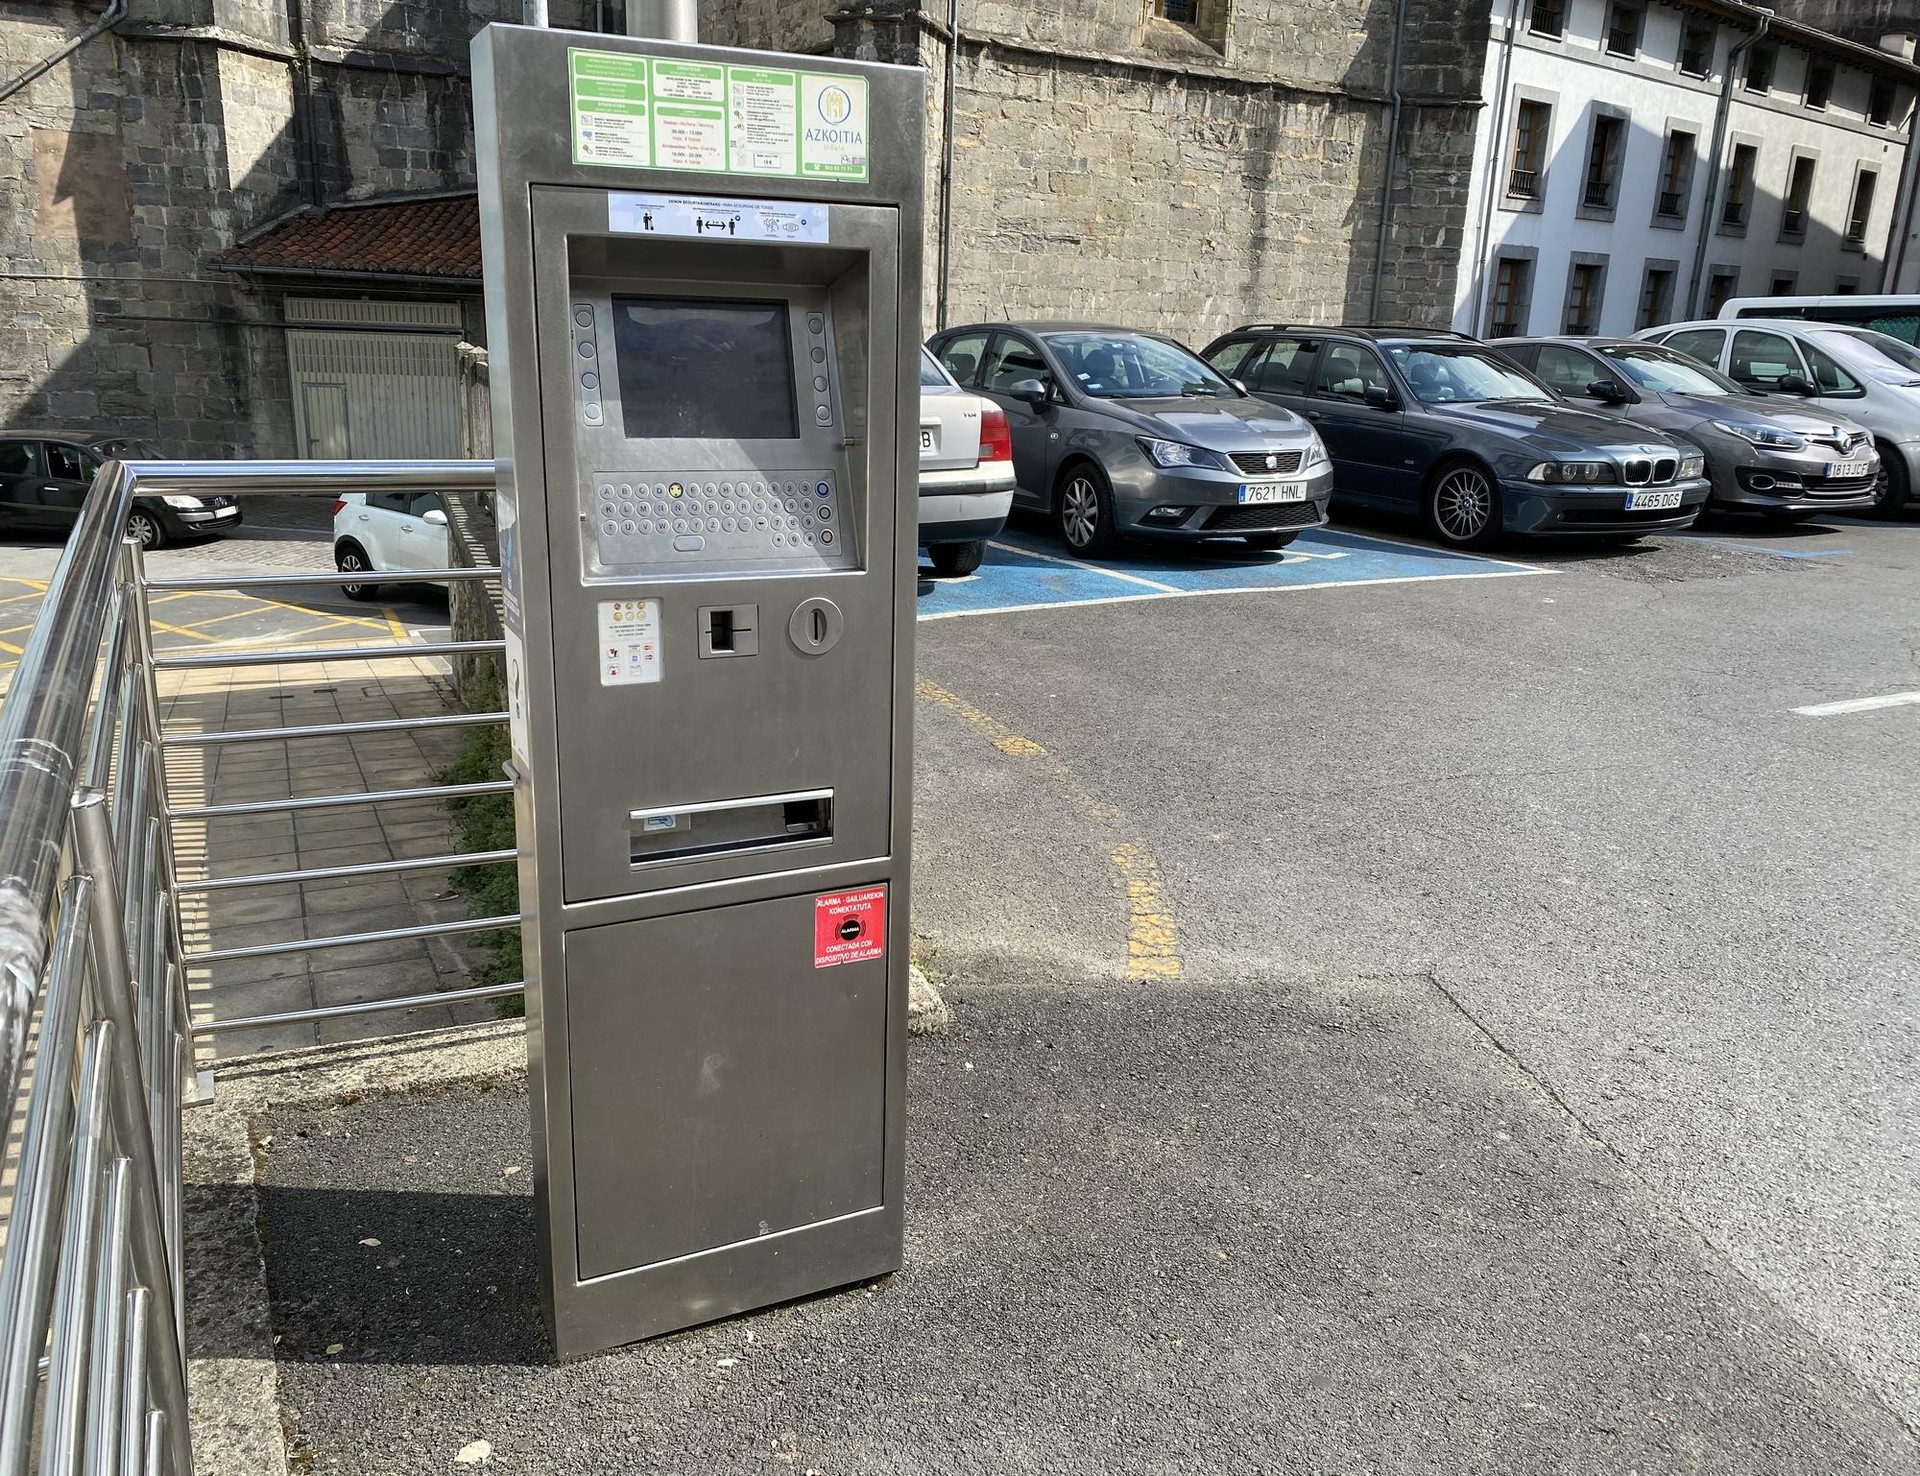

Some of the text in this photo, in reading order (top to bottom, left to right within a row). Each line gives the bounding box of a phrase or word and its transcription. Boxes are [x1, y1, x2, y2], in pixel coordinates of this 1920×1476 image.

[805, 128, 862, 144] AZKOITIA
[1833, 464, 1851, 475] 1813
[1248, 484, 1302, 501] 7621 HNL
[1635, 494, 1661, 507] 4465
[816, 898, 841, 907] ALARMA
[845, 891, 884, 903] GAILUAREKIN
[829, 903, 871, 915] KONEKTATUTA
[826, 942, 860, 953] CONECTADA
[850, 951, 858, 959] DE
[859, 948, 882, 957] ALARMA
